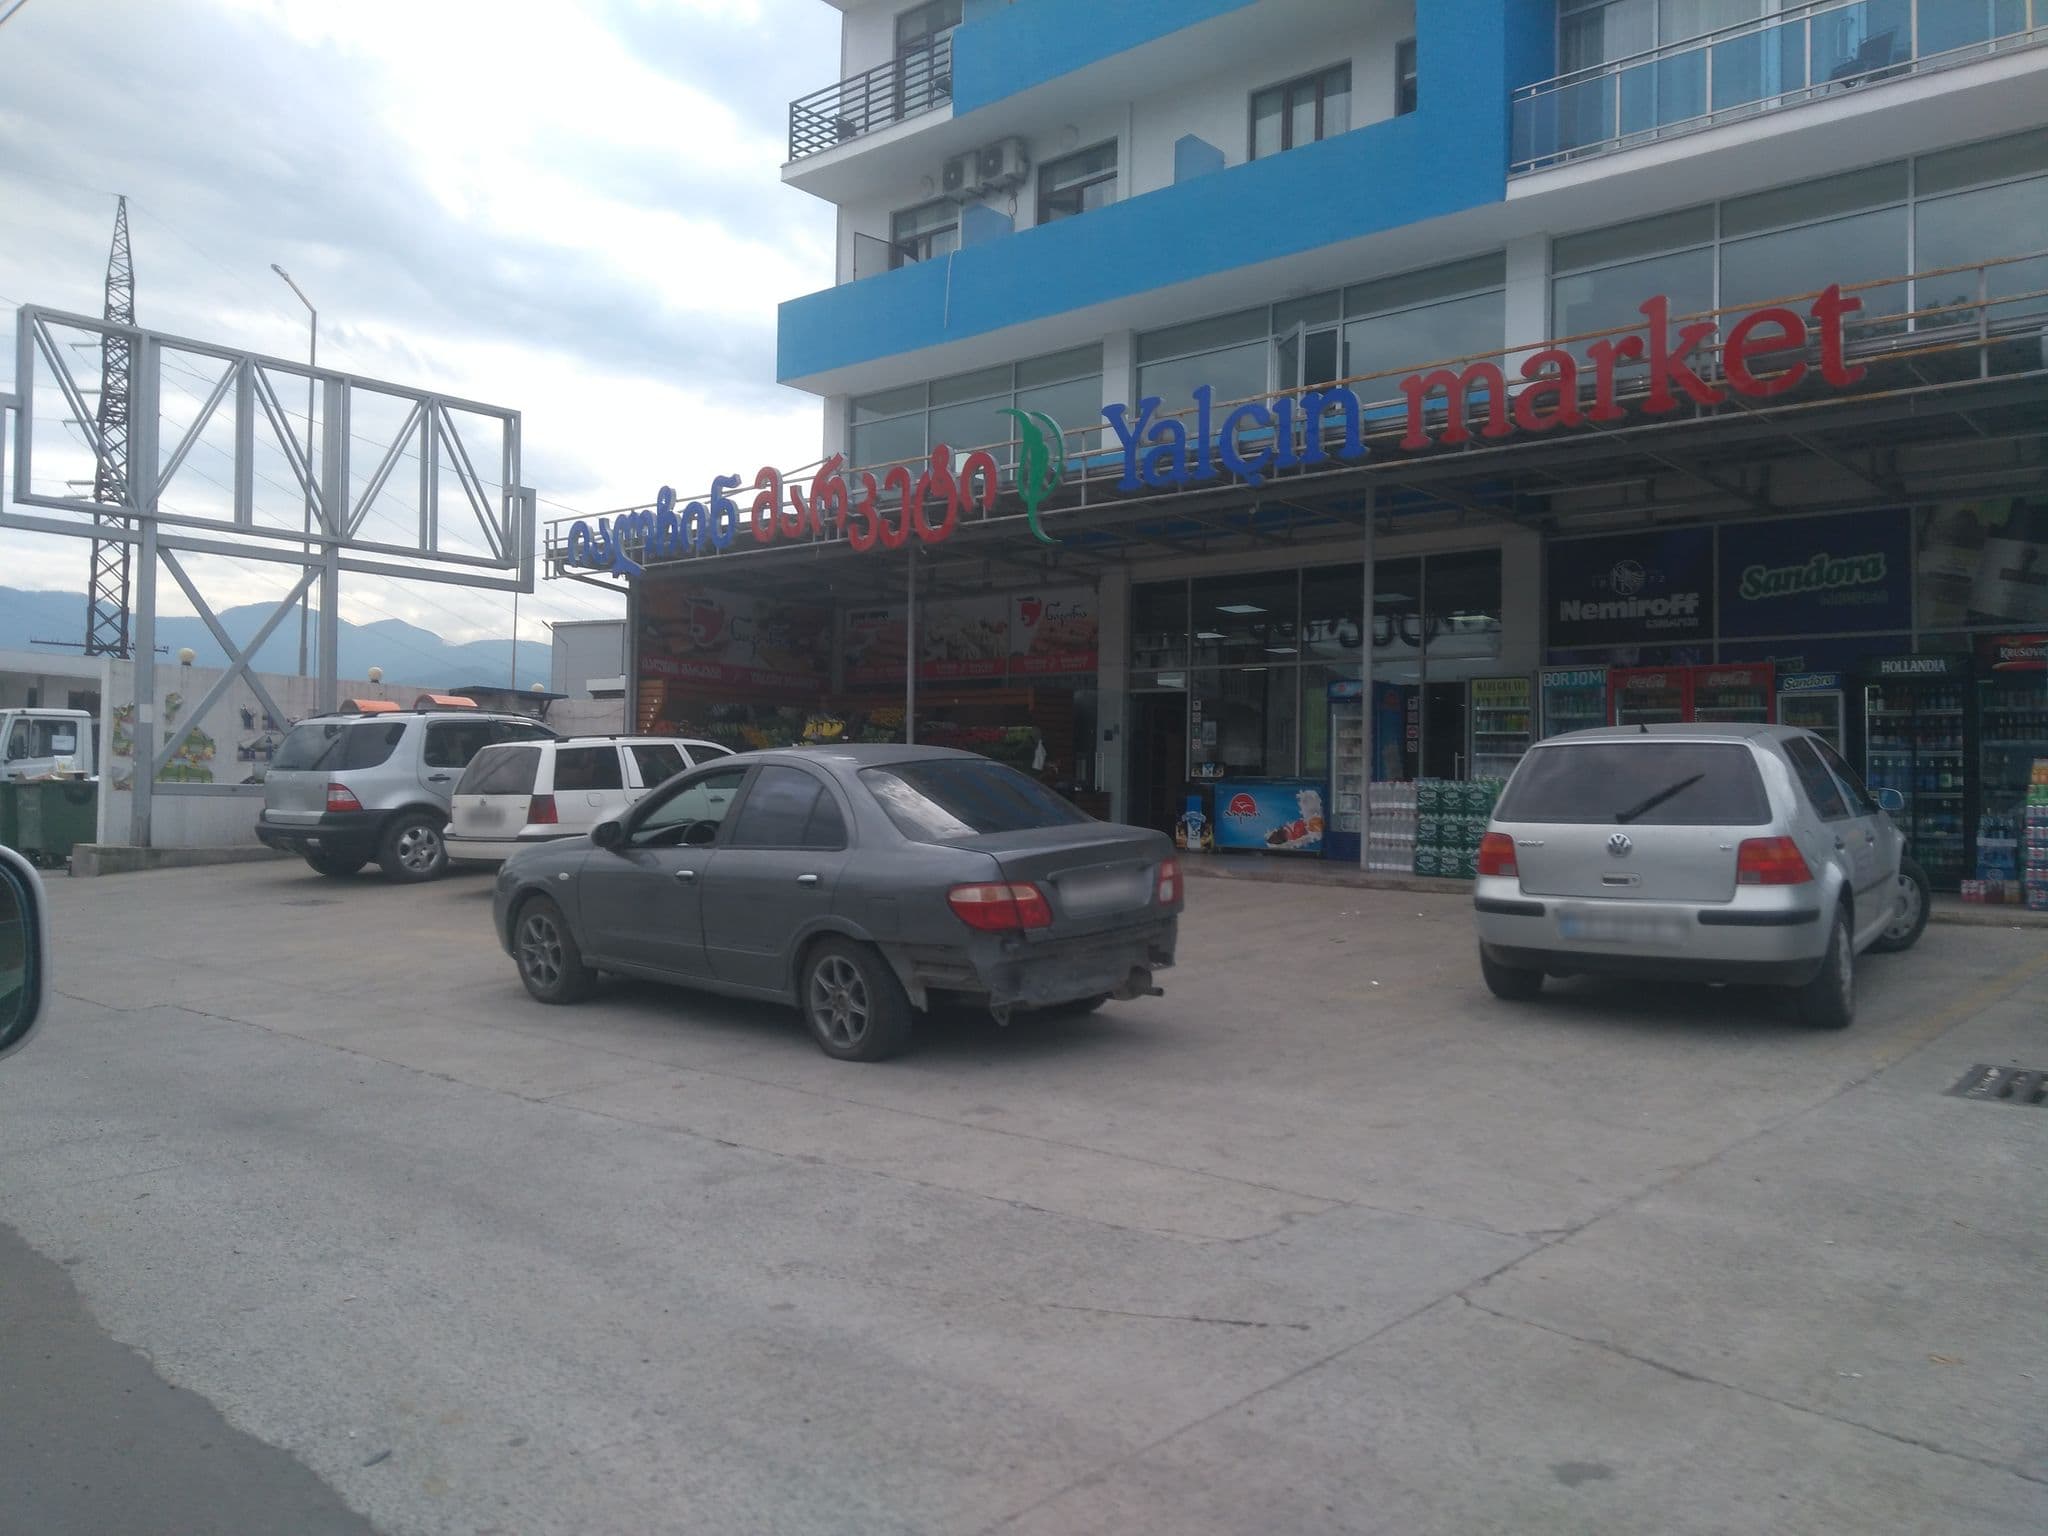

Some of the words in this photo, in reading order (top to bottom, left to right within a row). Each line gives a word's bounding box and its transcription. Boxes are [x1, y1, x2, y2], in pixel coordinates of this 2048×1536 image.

[1102, 384, 1372, 489] Yalçın
[1399, 283, 1867, 452] market
[567, 473, 742, 578] იალჩინ
[751, 443, 1001, 553] მარკეტი
[1739, 552, 1888, 600] Sandora
[1559, 592, 1701, 622] Nemiroff
[1881, 659, 1946, 673] HOLLANDIA
